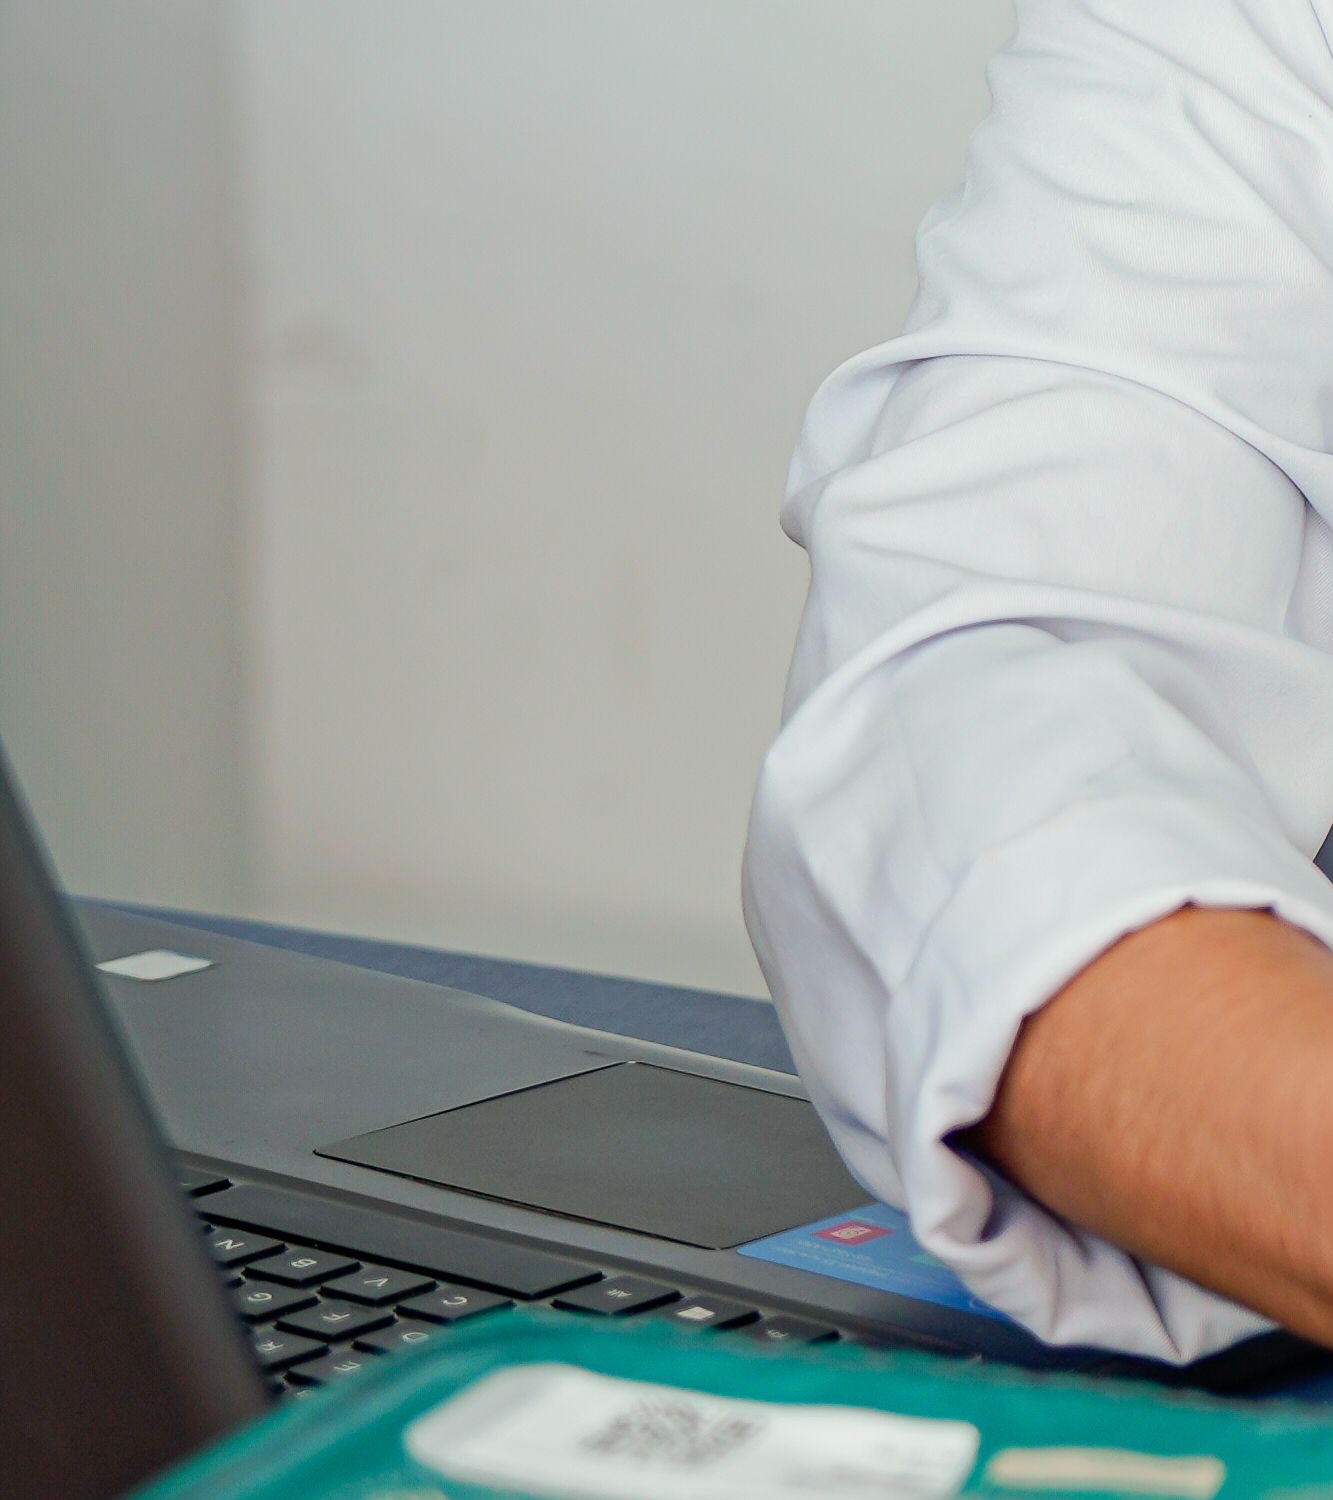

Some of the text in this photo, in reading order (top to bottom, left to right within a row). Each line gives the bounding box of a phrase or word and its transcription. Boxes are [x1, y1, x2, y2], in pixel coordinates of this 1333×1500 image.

[290, 1257, 317, 1268] B
[363, 1276, 389, 1288] V
[247, 1291, 273, 1302] G
[442, 1296, 468, 1306] C
[322, 1312, 350, 1323] F
[402, 1331, 429, 1344] D
[334, 1361, 361, 1373] E
